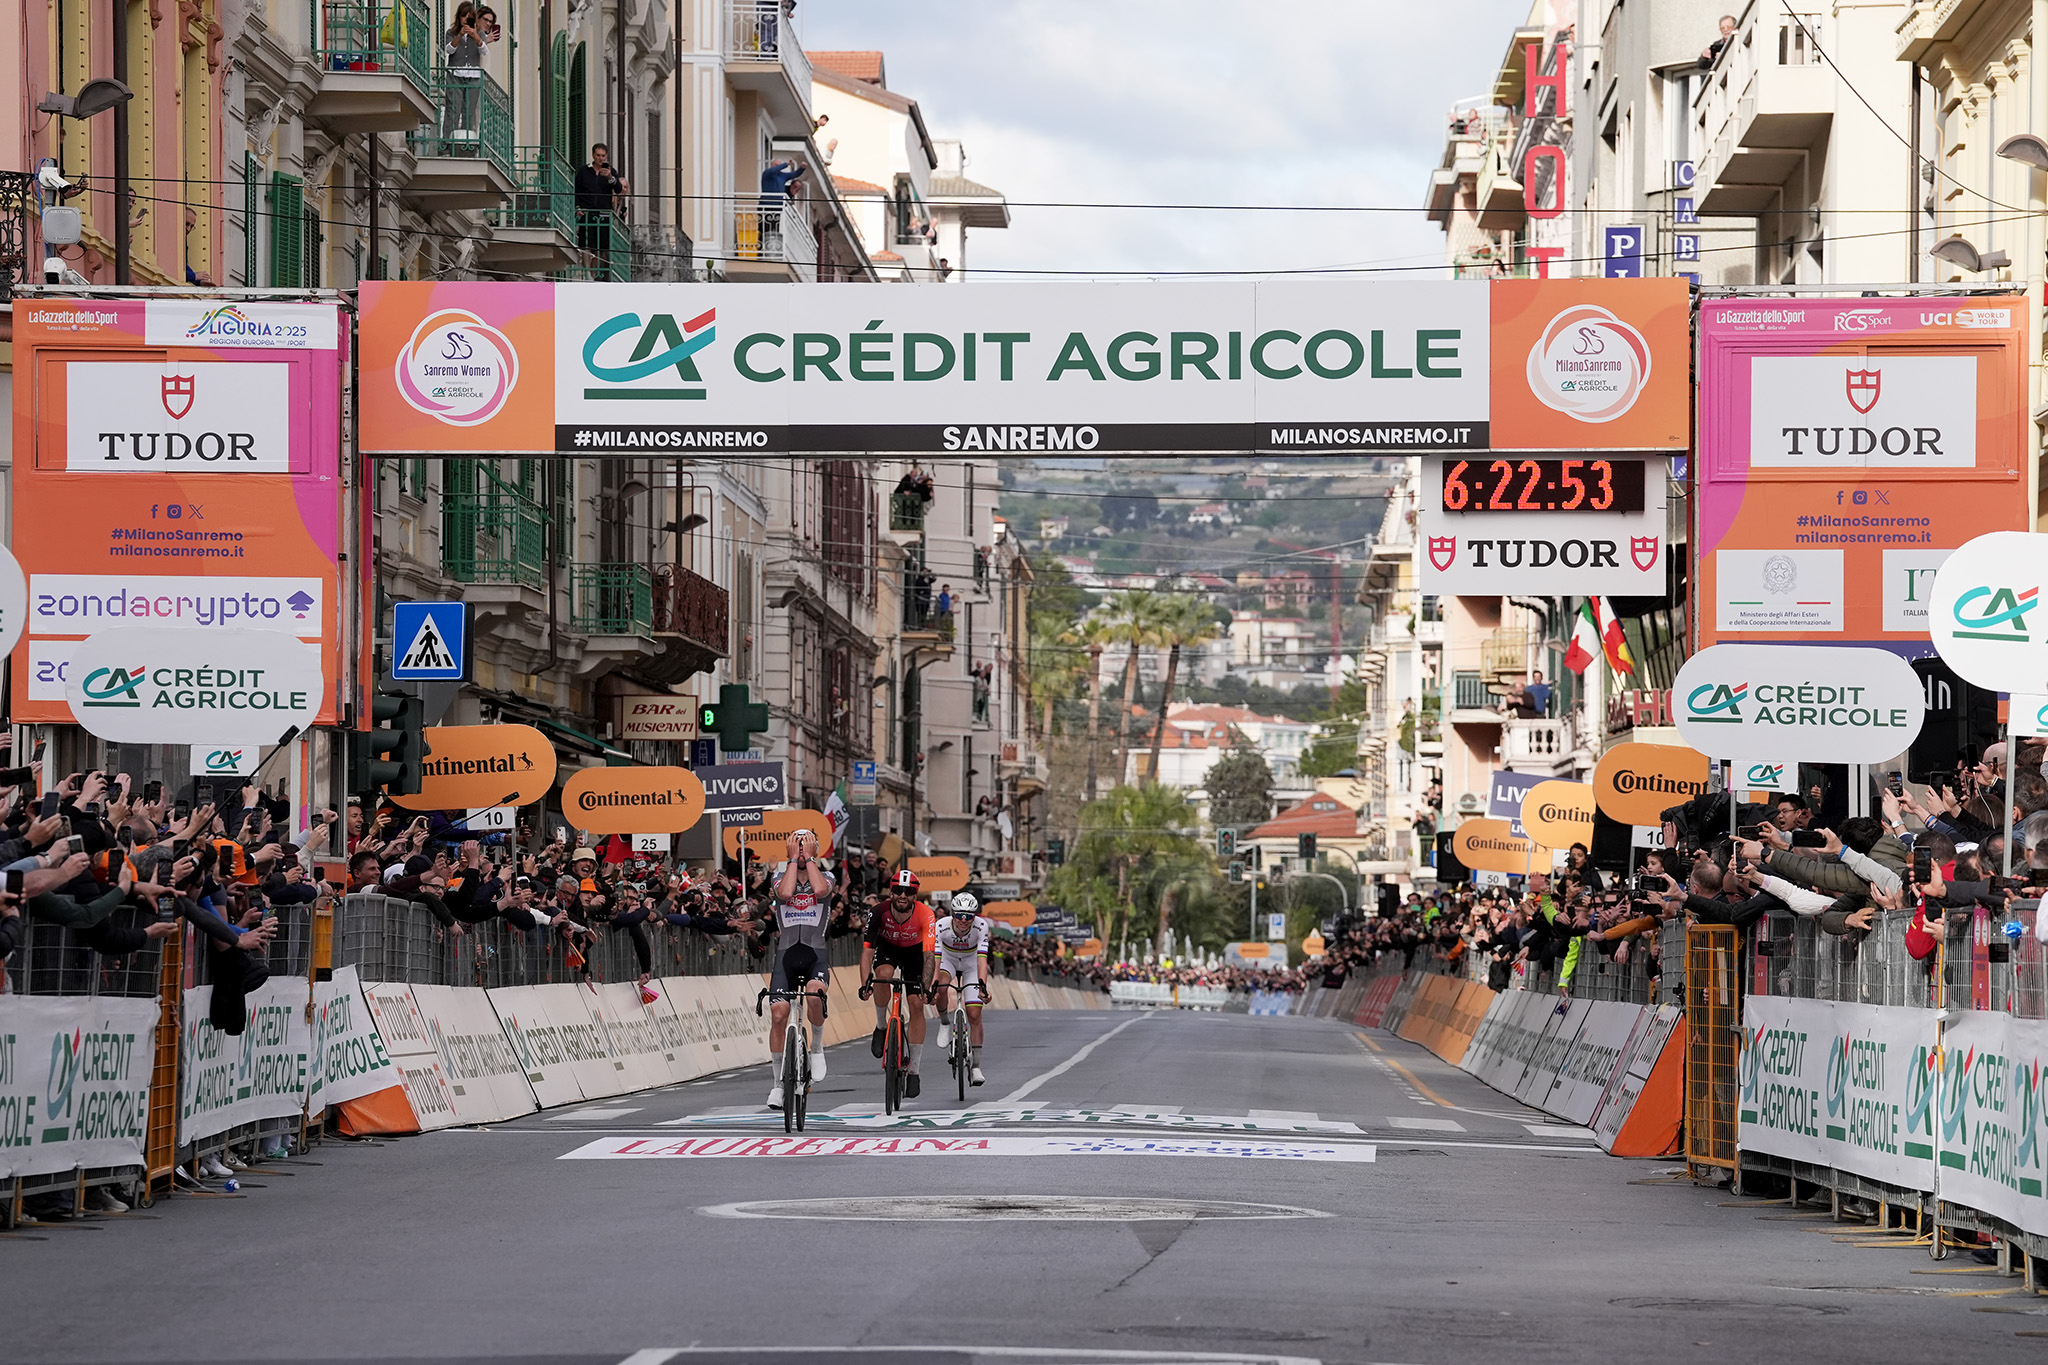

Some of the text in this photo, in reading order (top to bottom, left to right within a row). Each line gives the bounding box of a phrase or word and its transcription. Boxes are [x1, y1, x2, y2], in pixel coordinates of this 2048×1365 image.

[29, 310, 118, 326] La Gazzetta dello Sport
[1716, 310, 1805, 325] La Gazzetta dello Sport
[1834, 313, 1892, 331] RCS Sport
[1920, 313, 1952, 326] UCI
[275, 326, 307, 336] 2025
[734, 320, 1463, 383] CRÉDIT AGRICOLE
[424, 365, 491, 377] Sanremo Women
[1555, 359, 1622, 372] MilanoSanremo
[574, 431, 769, 448] #MILANOSANREMO
[943, 426, 1100, 450] SANREMO
[1271, 427, 1471, 445] MILANOSANREMO.IT
[1783, 427, 1943, 455] TUDOR
[98, 432, 257, 461] TUDOR
[1444, 460, 1614, 510] 6:22:53
[1797, 515, 1930, 528] #MilanoSanremo
[111, 528, 243, 542] #MilanoSanremo
[1795, 531, 1931, 544] milanosanremo.it
[110, 544, 244, 558] milanosanremo.it
[1468, 539, 1620, 568] TUDOR
[37, 588, 281, 626] zondacrypto
[152, 664, 265, 688] CRÉDIT
[152, 690, 307, 710] AGRICOLE
[1754, 682, 1866, 706] CRÉDIT
[632, 704, 675, 715] BAR
[1754, 706, 1907, 728] AGRICOLE
[624, 723, 694, 733] MUSICANTI
[727, 750, 762, 760] HOTEL
[702, 776, 779, 795] LIVIGNO
[578, 790, 672, 811] Continental
[485, 812, 503, 826] 10
[722, 812, 761, 822] LIVIGNO
[641, 838, 657, 851] 25
[1466, 836, 1538, 854] Continental
[1647, 831, 1665, 846] 10
[1487, 875, 1499, 884] 50
[882, 929, 918, 939] INEOS
[927, 914, 936, 938] INEOS
[255, 996, 292, 1048] CRÉDIT
[325, 987, 353, 1040] CRÉDIT
[377, 996, 421, 1041] TUDOR
[82, 1021, 135, 1081] CRÉDIT
[1762, 1019, 1807, 1078] CRÉDIT
[323, 1032, 391, 1086] AGRICOLE
[1851, 1028, 1887, 1092] CRÉDIT
[251, 1053, 308, 1097] AGRICOLE
[193, 1062, 235, 1115] AGRICOLE
[405, 1067, 449, 1114] TUDOR
[73, 1090, 146, 1141] AGRICOLE
[1760, 1083, 1819, 1138] AGRICOLE
[1849, 1097, 1899, 1155] AGRICOLE
[610, 1137, 991, 1156] LAURETANA
